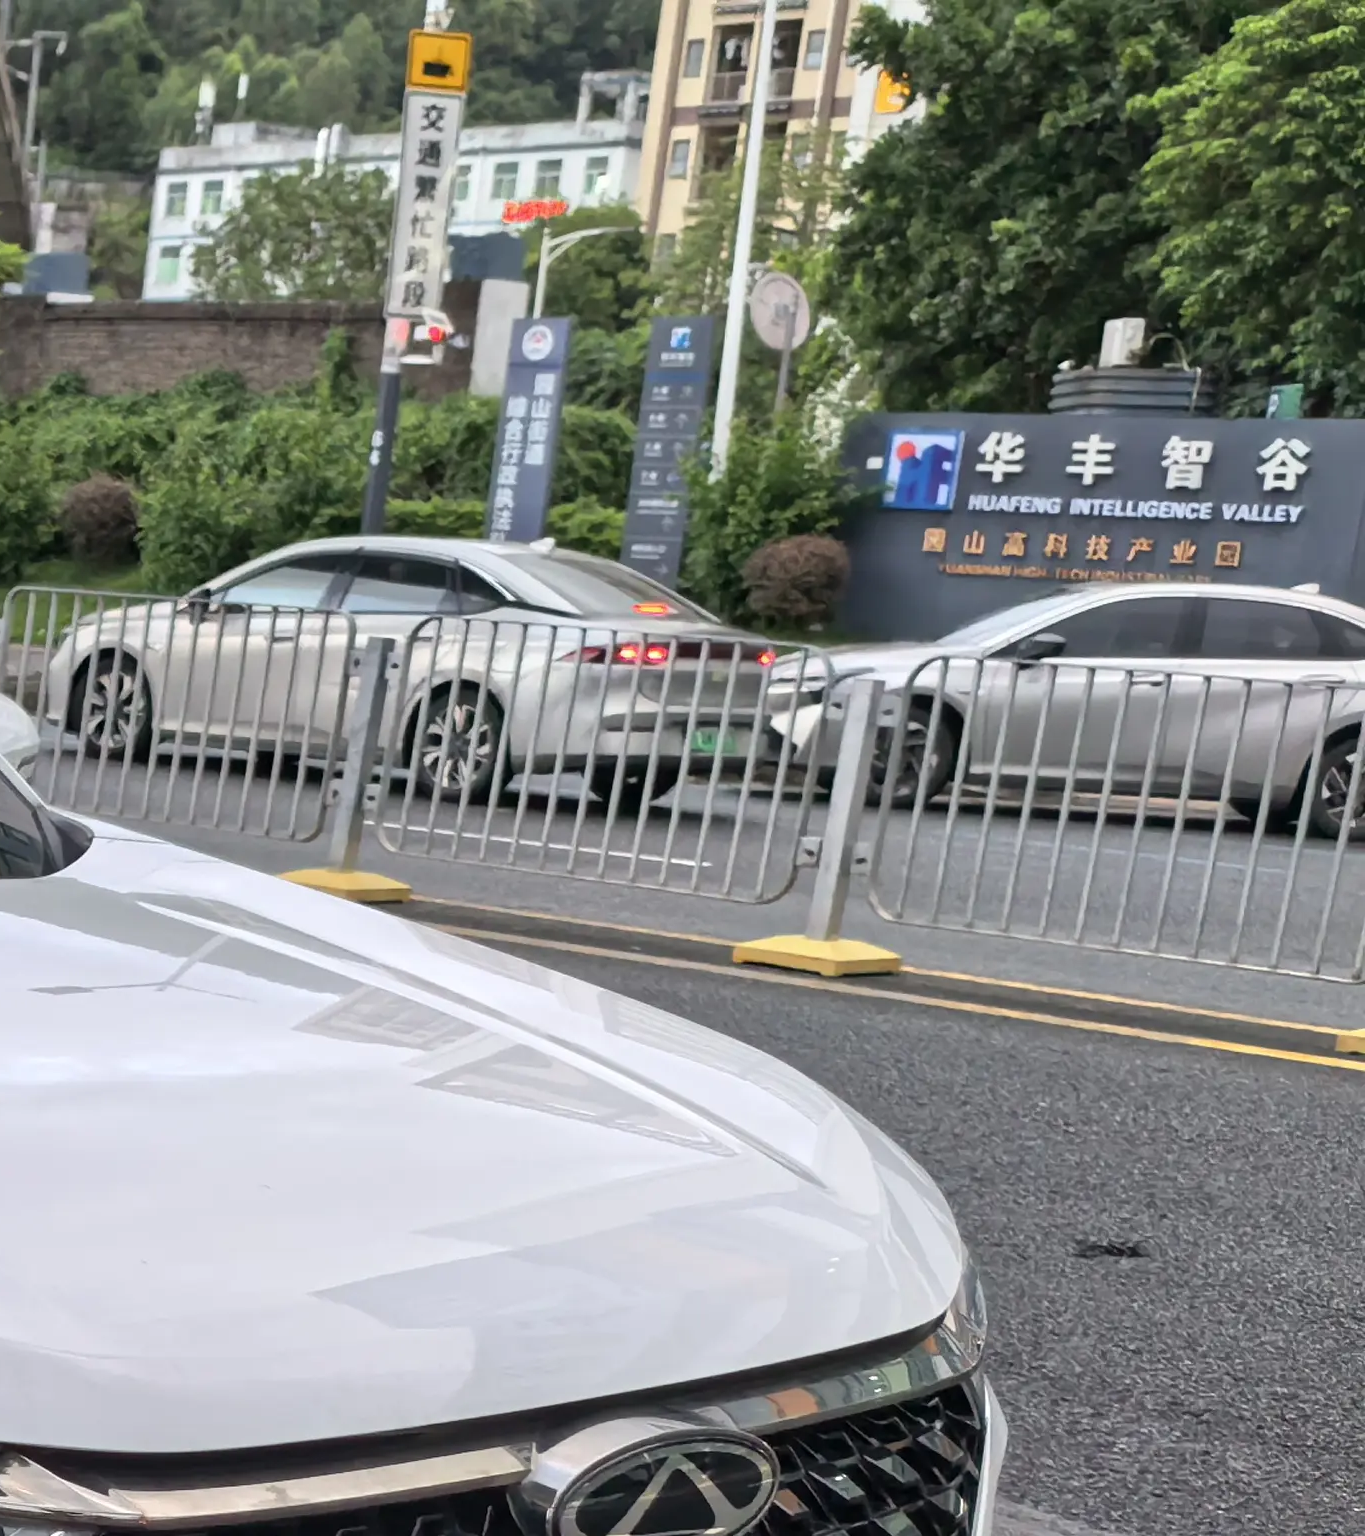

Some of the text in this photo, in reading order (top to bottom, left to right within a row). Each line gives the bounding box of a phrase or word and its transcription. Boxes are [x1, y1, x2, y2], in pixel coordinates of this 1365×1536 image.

[975, 431, 1312, 492] 华丰智谷
[967, 493, 1305, 524] HUAFENG INTELLIGENCE VALLEY
